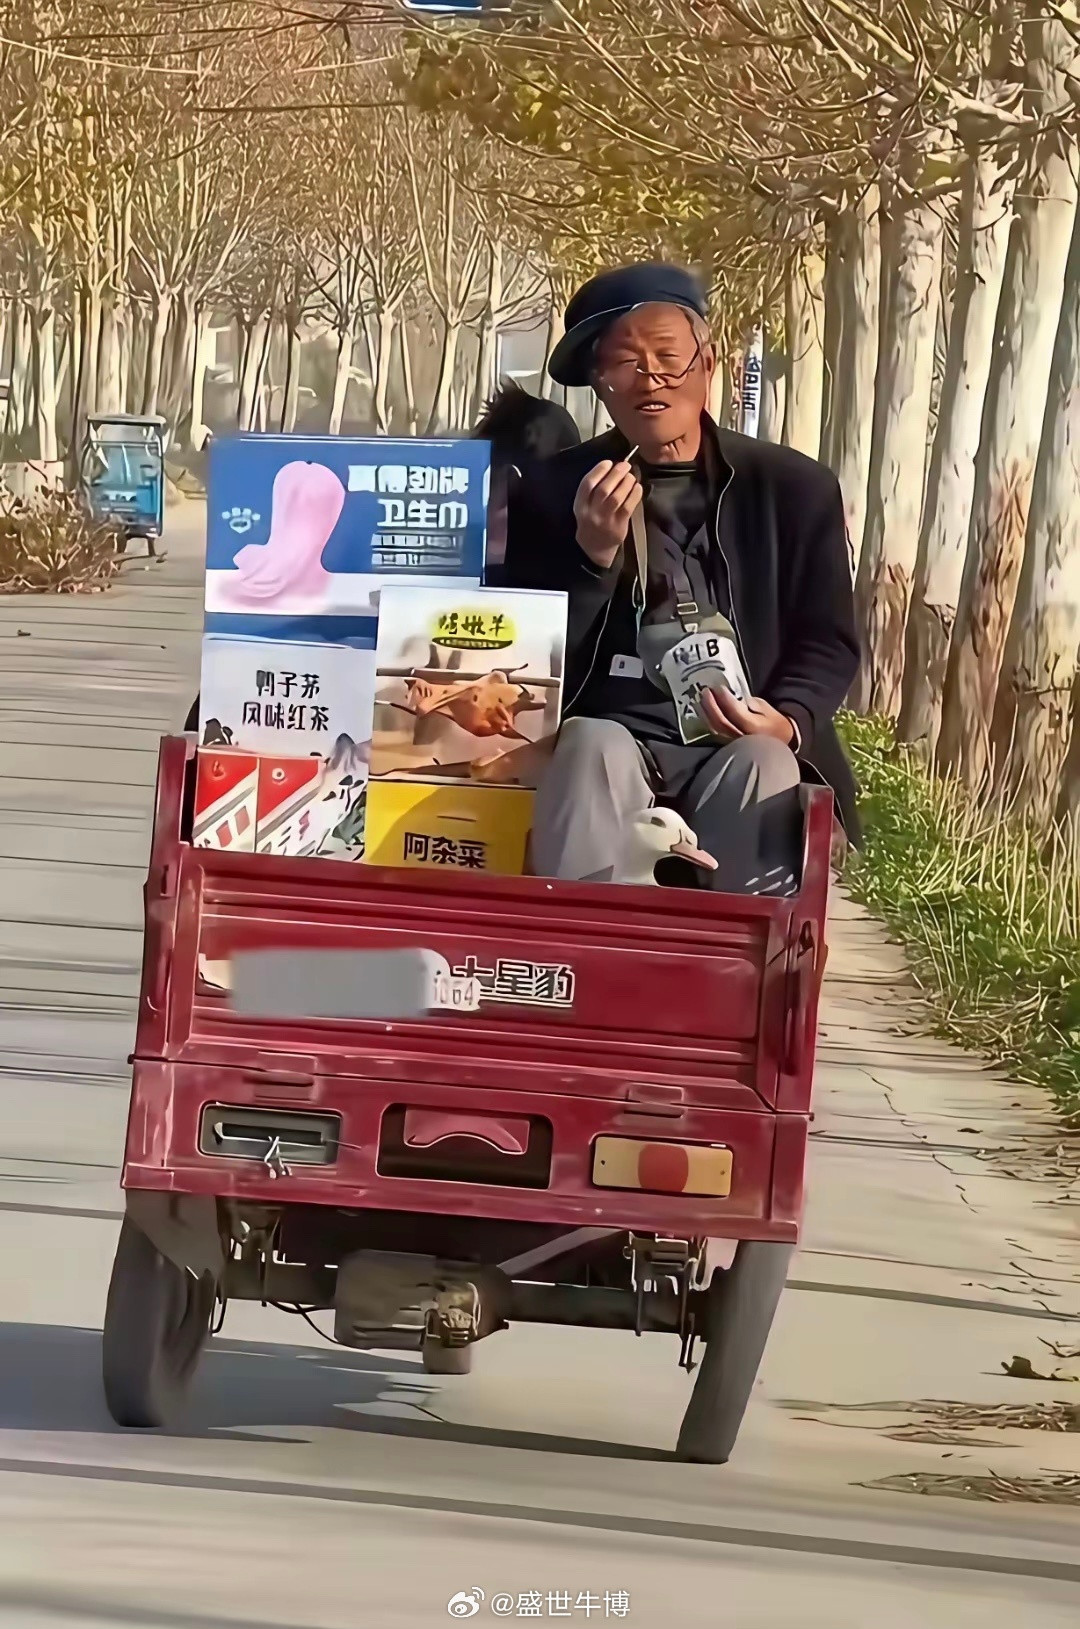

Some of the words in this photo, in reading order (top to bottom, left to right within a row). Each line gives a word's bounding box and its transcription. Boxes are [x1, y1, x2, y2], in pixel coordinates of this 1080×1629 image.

[376, 498, 468, 529] 卫生巾
[242, 701, 329, 731] 风味红茶
